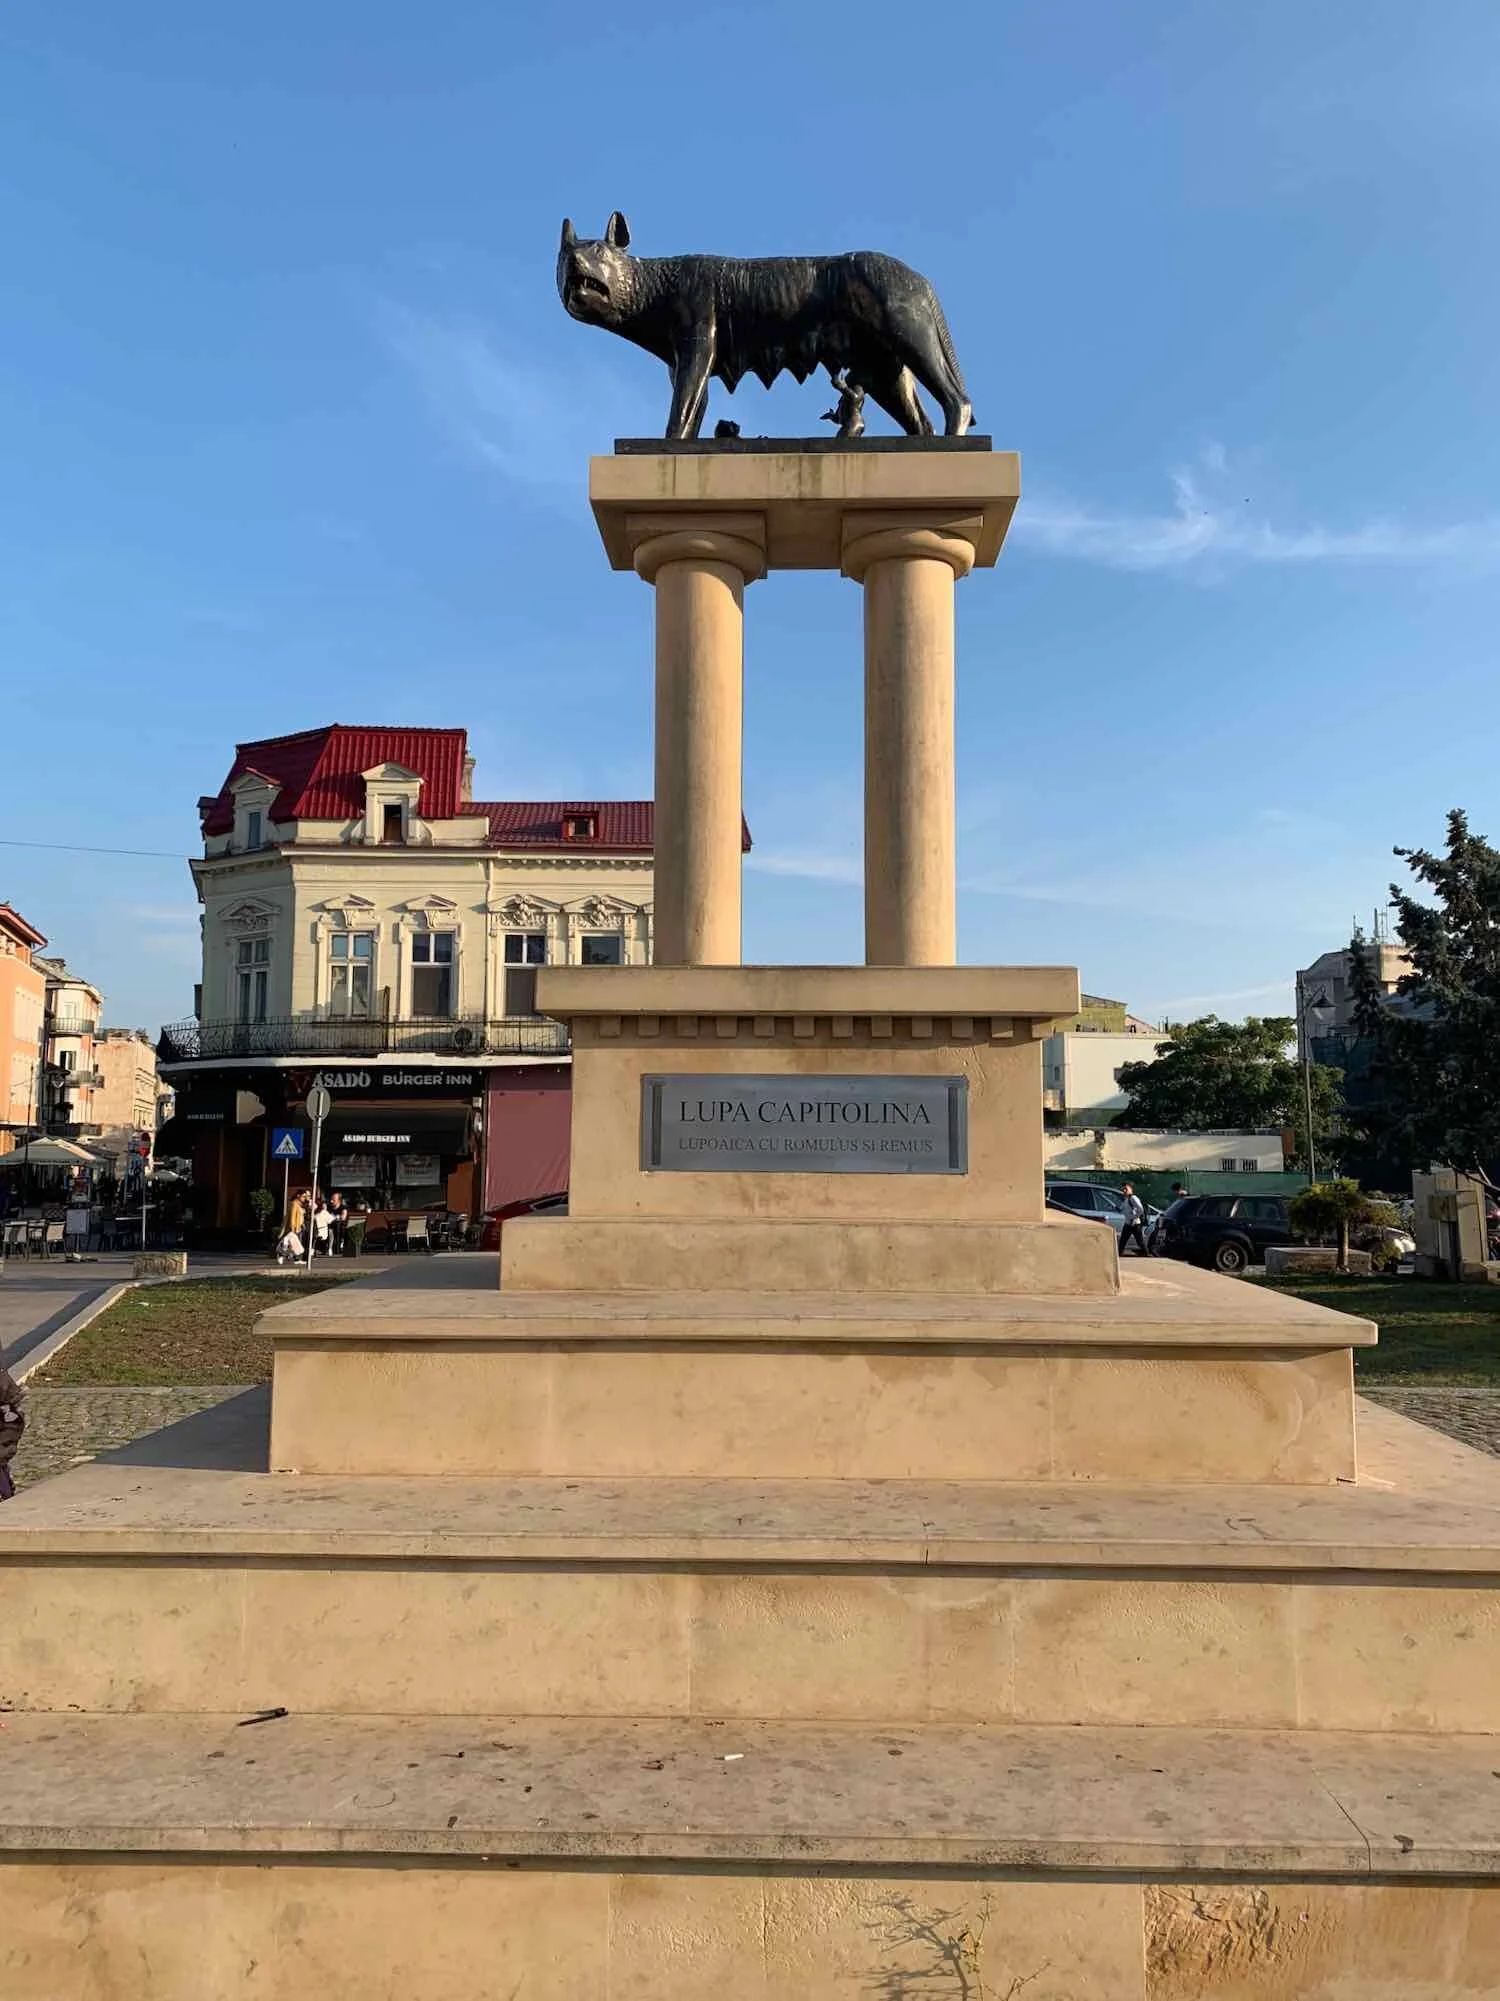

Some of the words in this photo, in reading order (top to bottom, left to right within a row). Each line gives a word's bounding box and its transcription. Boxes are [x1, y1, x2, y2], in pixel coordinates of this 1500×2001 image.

[312, 1073, 371, 1088] ASADO
[383, 1074, 442, 1086] BURGER
[446, 1074, 472, 1086] INN
[680, 1101, 751, 1122] LUPA
[758, 1101, 930, 1124] CAPITOLINA
[343, 1134, 366, 1143] ASADO
[397, 1134, 411, 1143] INN
[679, 1138, 754, 1151] LUPOAICA
[759, 1138, 779, 1151] CU
[784, 1138, 858, 1152] ROMULUS
[880, 1139, 933, 1153] REMUS
